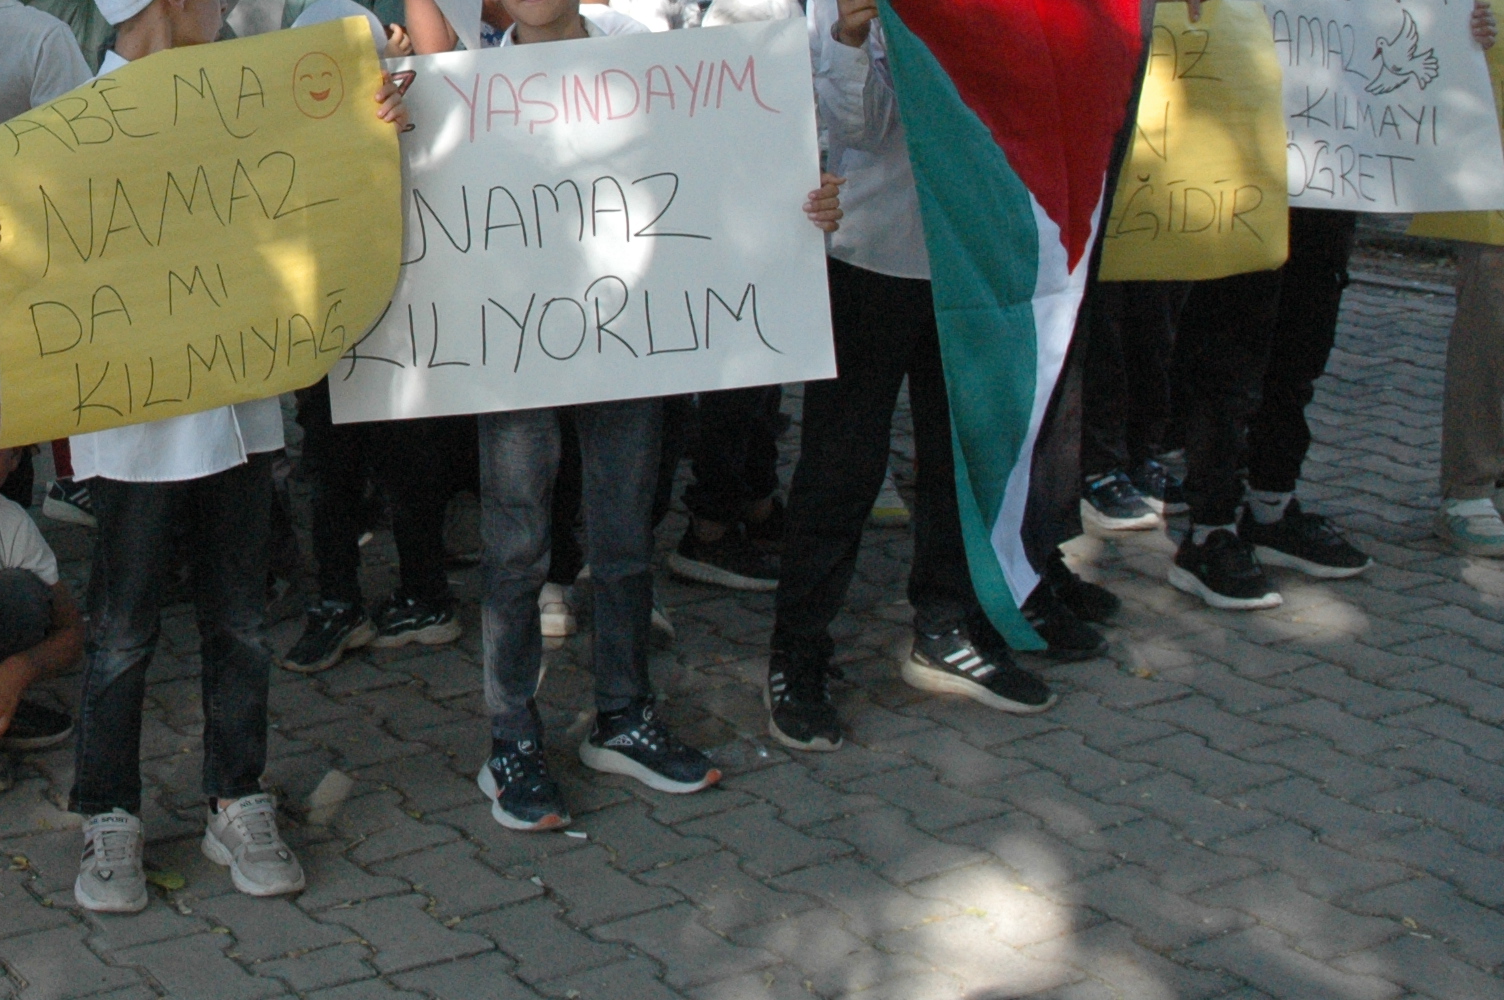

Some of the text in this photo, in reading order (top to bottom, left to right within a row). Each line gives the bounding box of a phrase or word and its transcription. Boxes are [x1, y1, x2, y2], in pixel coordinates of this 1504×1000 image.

[1146, 25, 1222, 82] AZ
[1263, 5, 1370, 81] AMAZ
[173, 65, 266, 139] MA
[444, 55, 782, 143] YAŞINDAYIM
[1290, 85, 1437, 146] KILMAYI
[39, 150, 340, 279] NAMAZ
[401, 172, 712, 266] NAMAZ
[1105, 174, 1264, 243] ĞİDİR
[29, 263, 228, 359] DA MI
[340, 275, 786, 381] KILIYORUM
